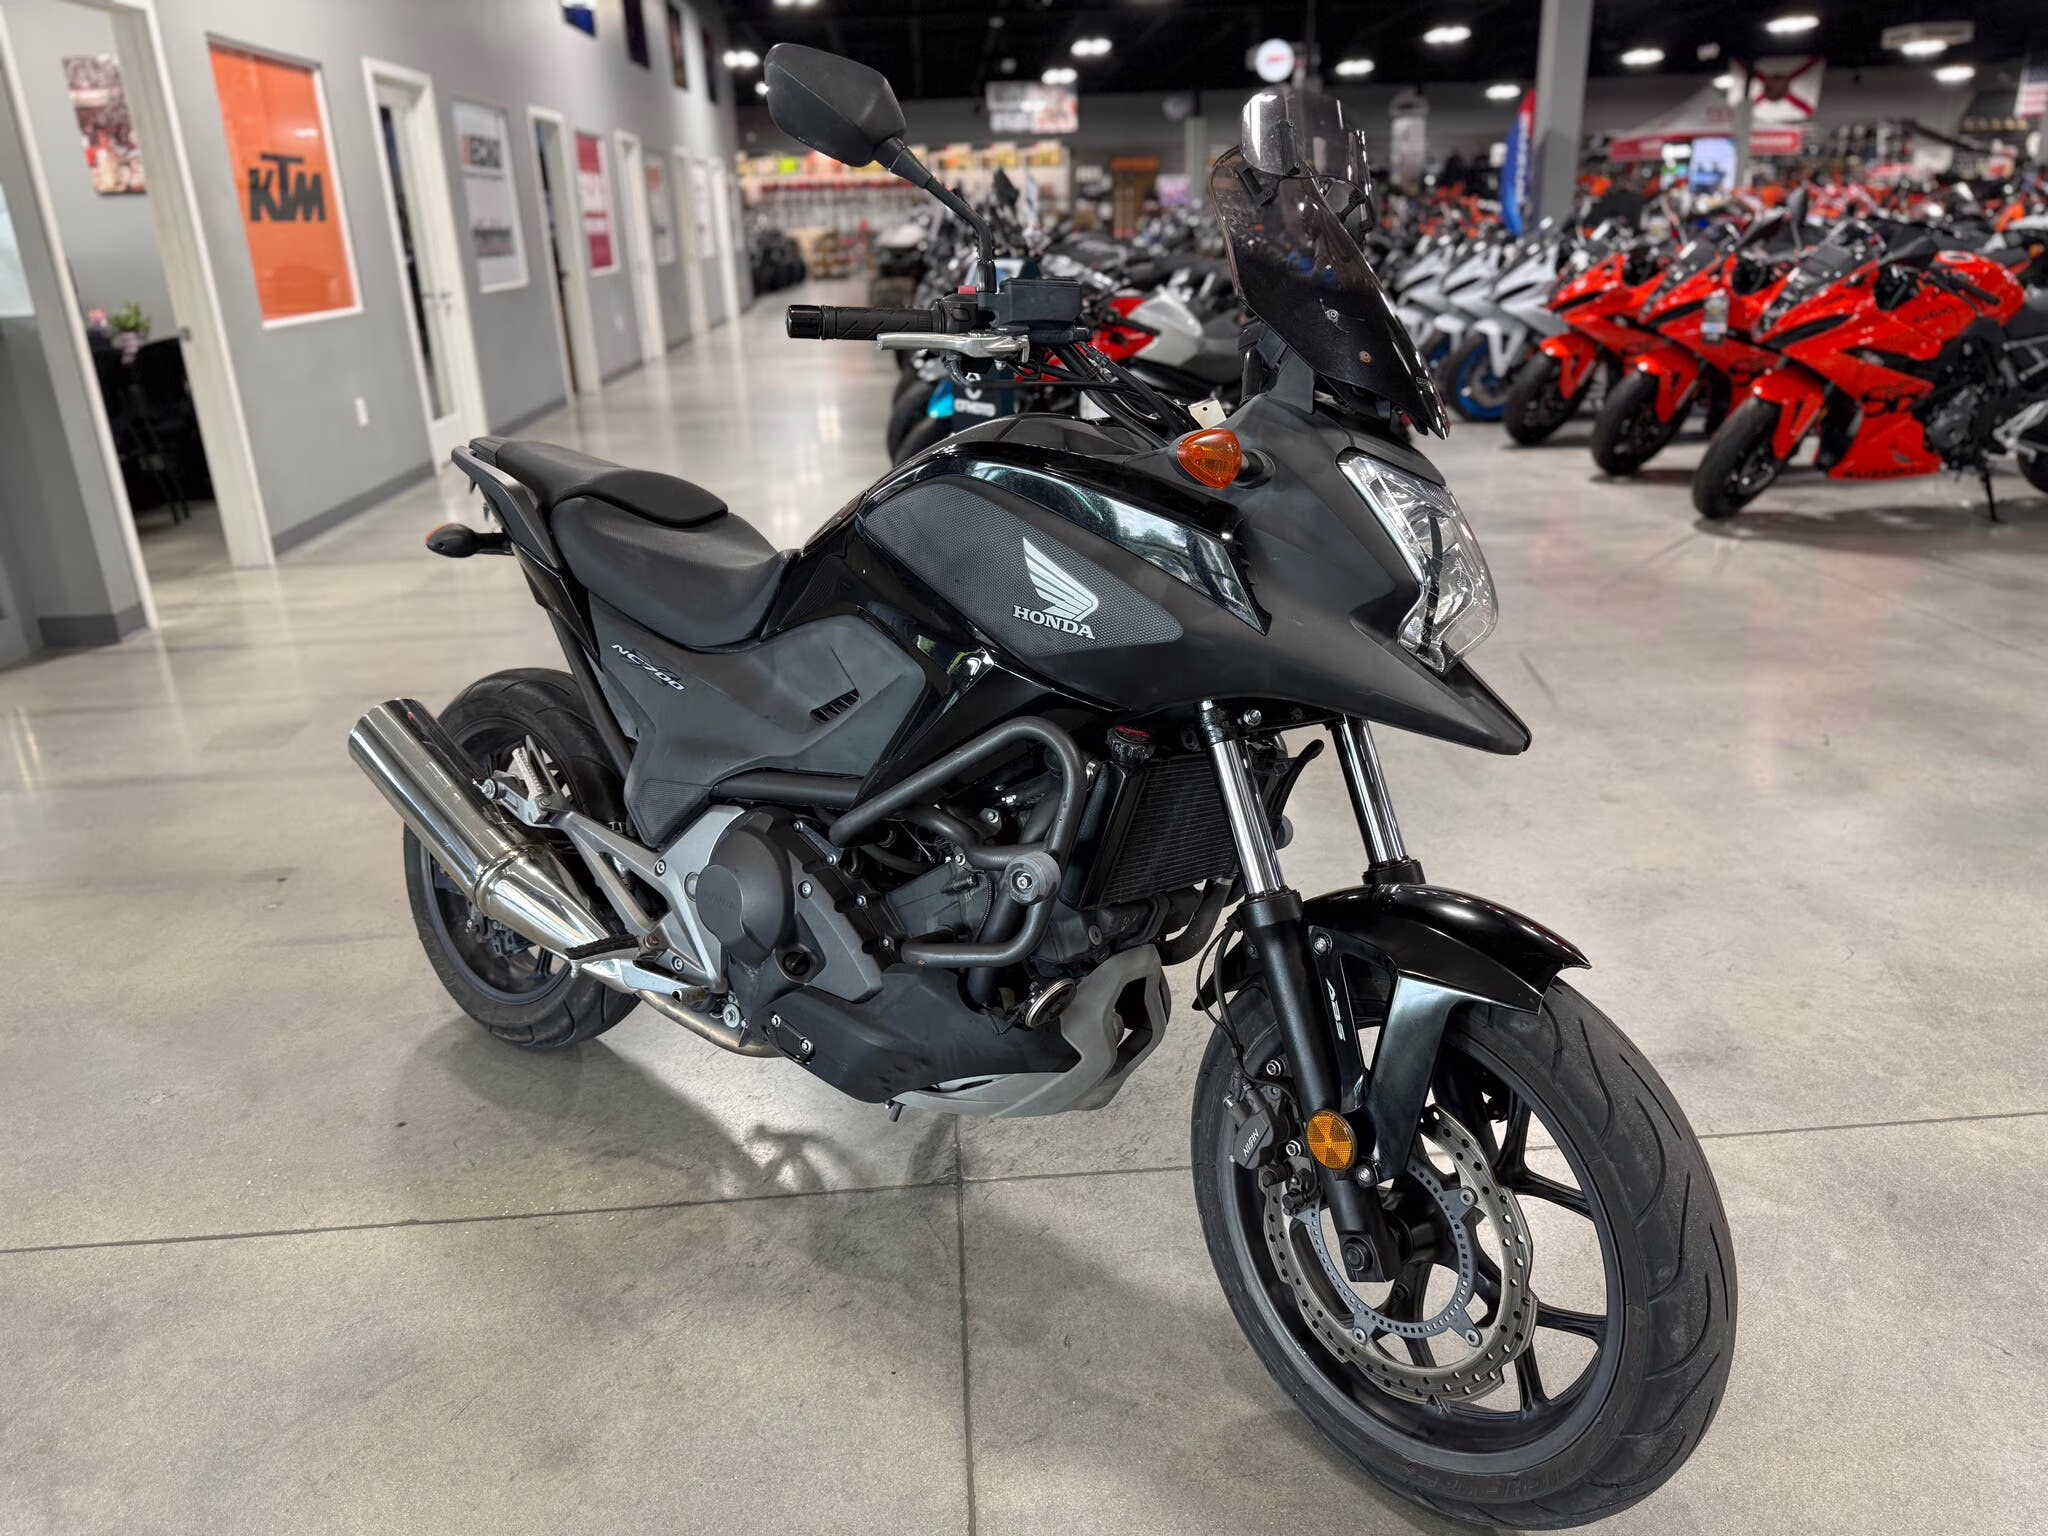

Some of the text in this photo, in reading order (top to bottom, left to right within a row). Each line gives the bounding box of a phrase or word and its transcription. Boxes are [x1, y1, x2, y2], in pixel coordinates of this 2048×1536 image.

[248, 152, 327, 222] KTM
[1013, 605, 1096, 640] HONDA
[1325, 977, 1347, 1042] ABS
